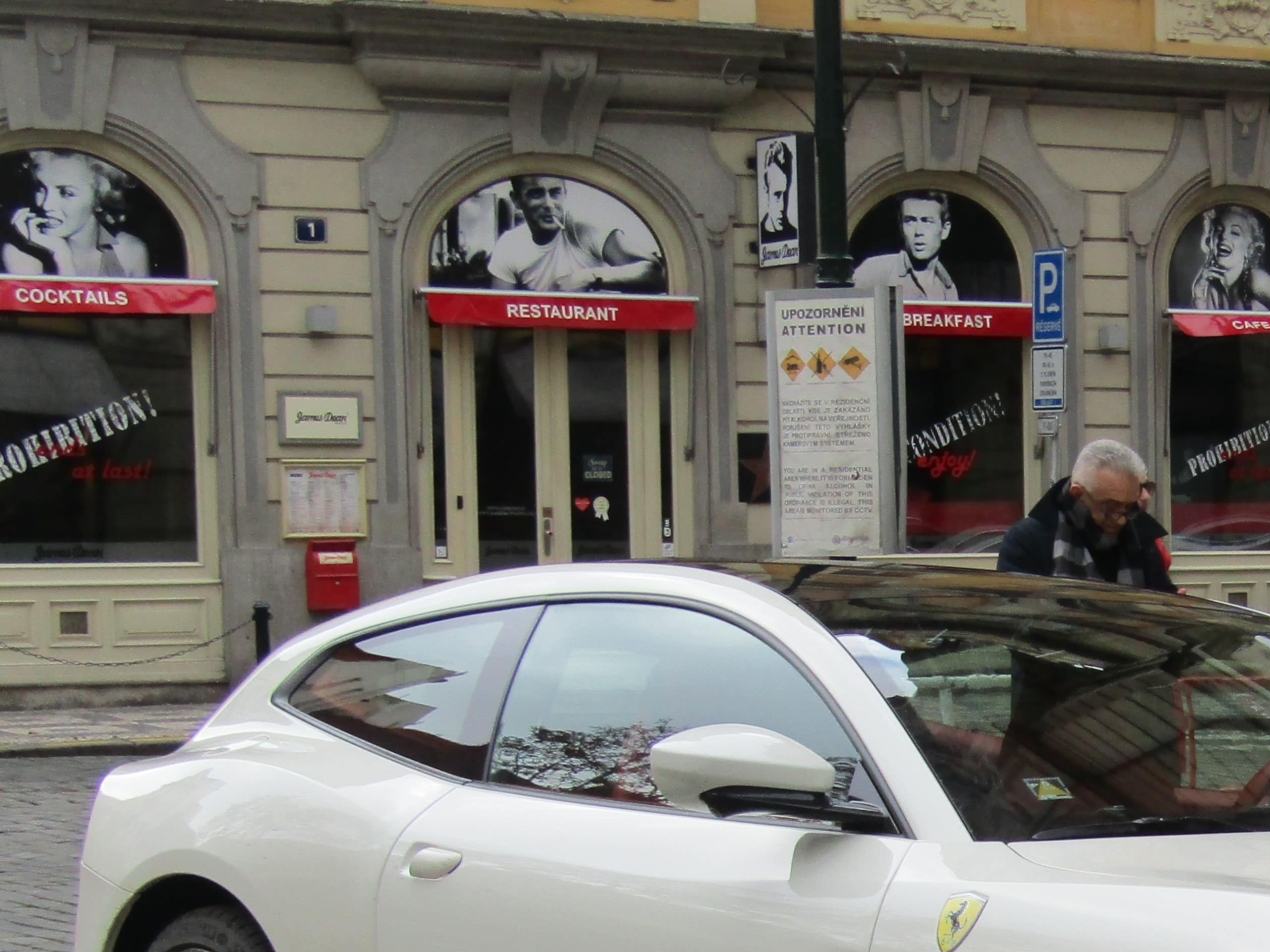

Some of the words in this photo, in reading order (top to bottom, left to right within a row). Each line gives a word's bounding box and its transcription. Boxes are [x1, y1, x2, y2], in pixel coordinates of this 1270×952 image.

[307, 222, 315, 238] 1
[1039, 262, 1058, 314] P
[15, 288, 129, 306] COCKTAILS
[507, 303, 618, 322] RESTAURANT
[781, 304, 865, 320] UPOZORNĚNÍ
[903, 313, 993, 329] BREAKFAST
[1036, 319, 1062, 333] RÉSERVÉ
[782, 323, 866, 336] ATTENTION
[294, 411, 324, 424] James
[324, 411, 347, 423] Dean
[906, 391, 1006, 464] ONDITION!
[102, 458, 154, 481] last!
[916, 449, 978, 478] enjoy!
[584, 471, 613, 479] CLOSED
